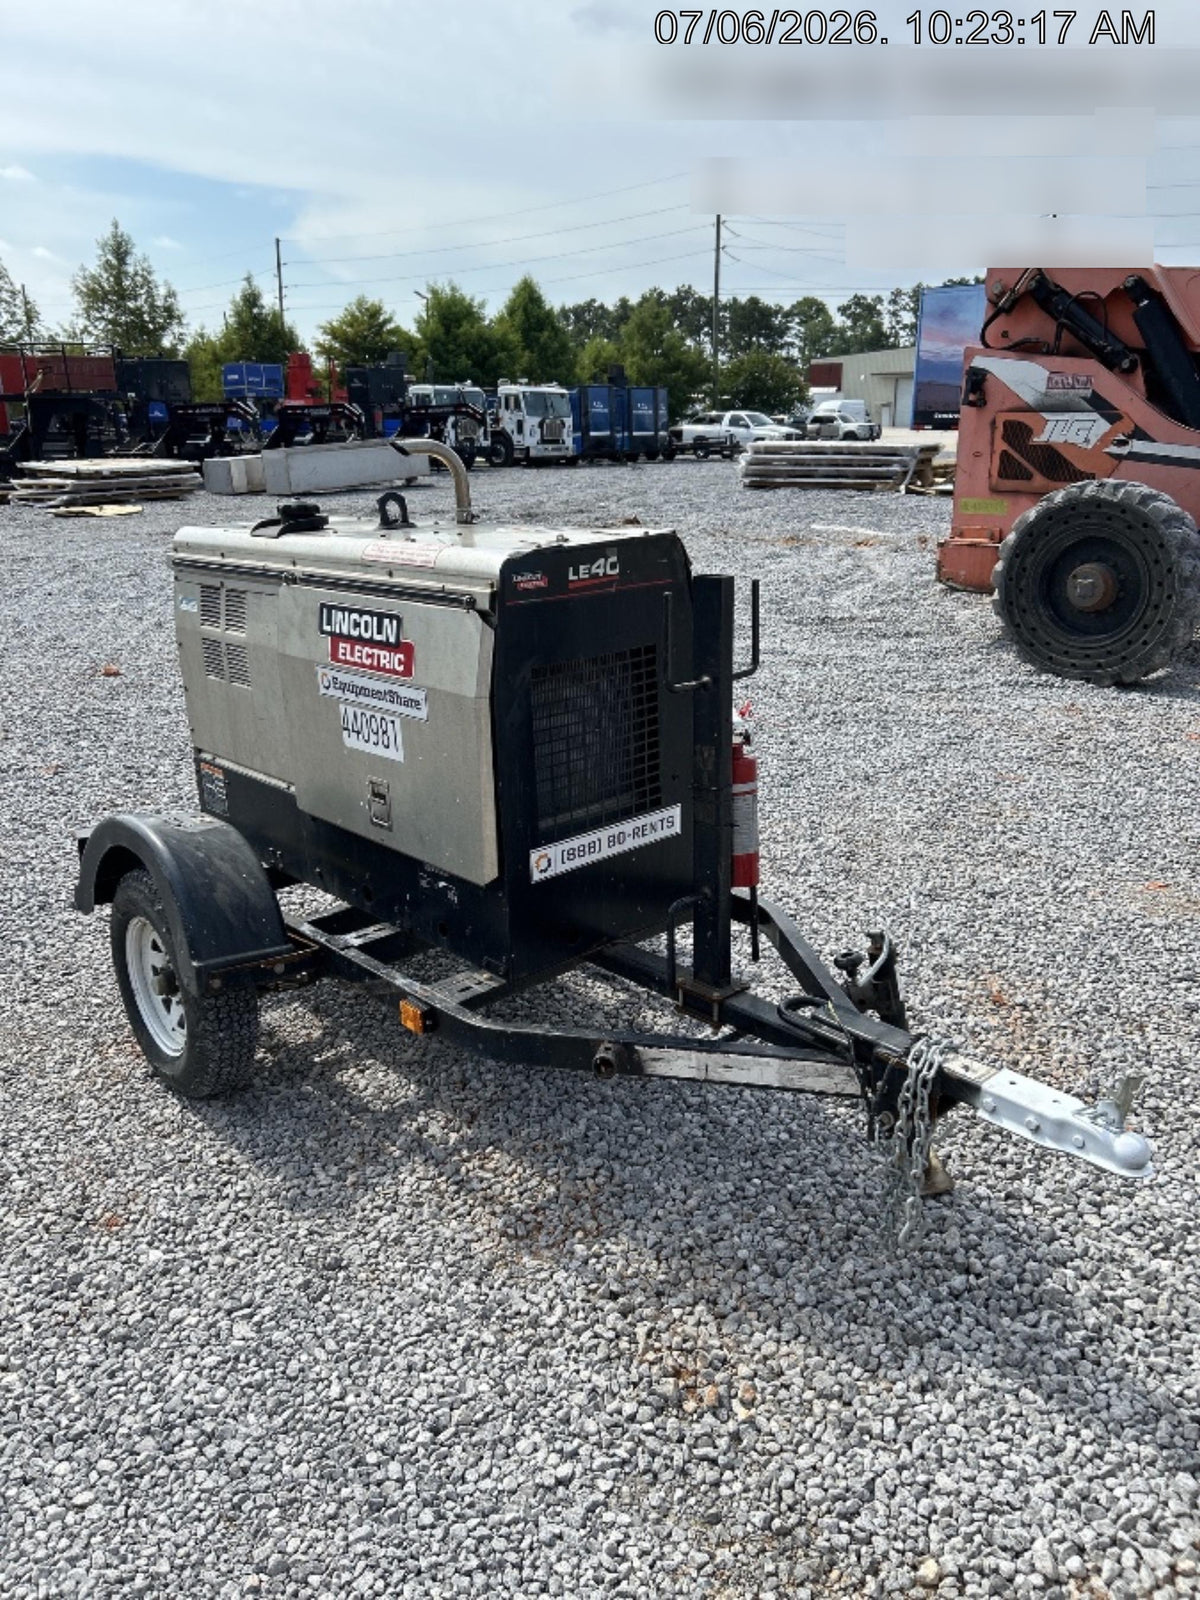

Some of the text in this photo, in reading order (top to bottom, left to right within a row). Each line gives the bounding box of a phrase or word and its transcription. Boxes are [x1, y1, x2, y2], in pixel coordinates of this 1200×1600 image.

[322, 608, 397, 643] LINCOLN
[338, 642, 405, 672] ELECTRIC
[332, 676, 422, 711] EquipmentShare
[607, 816, 675, 848] 80-RENTS
